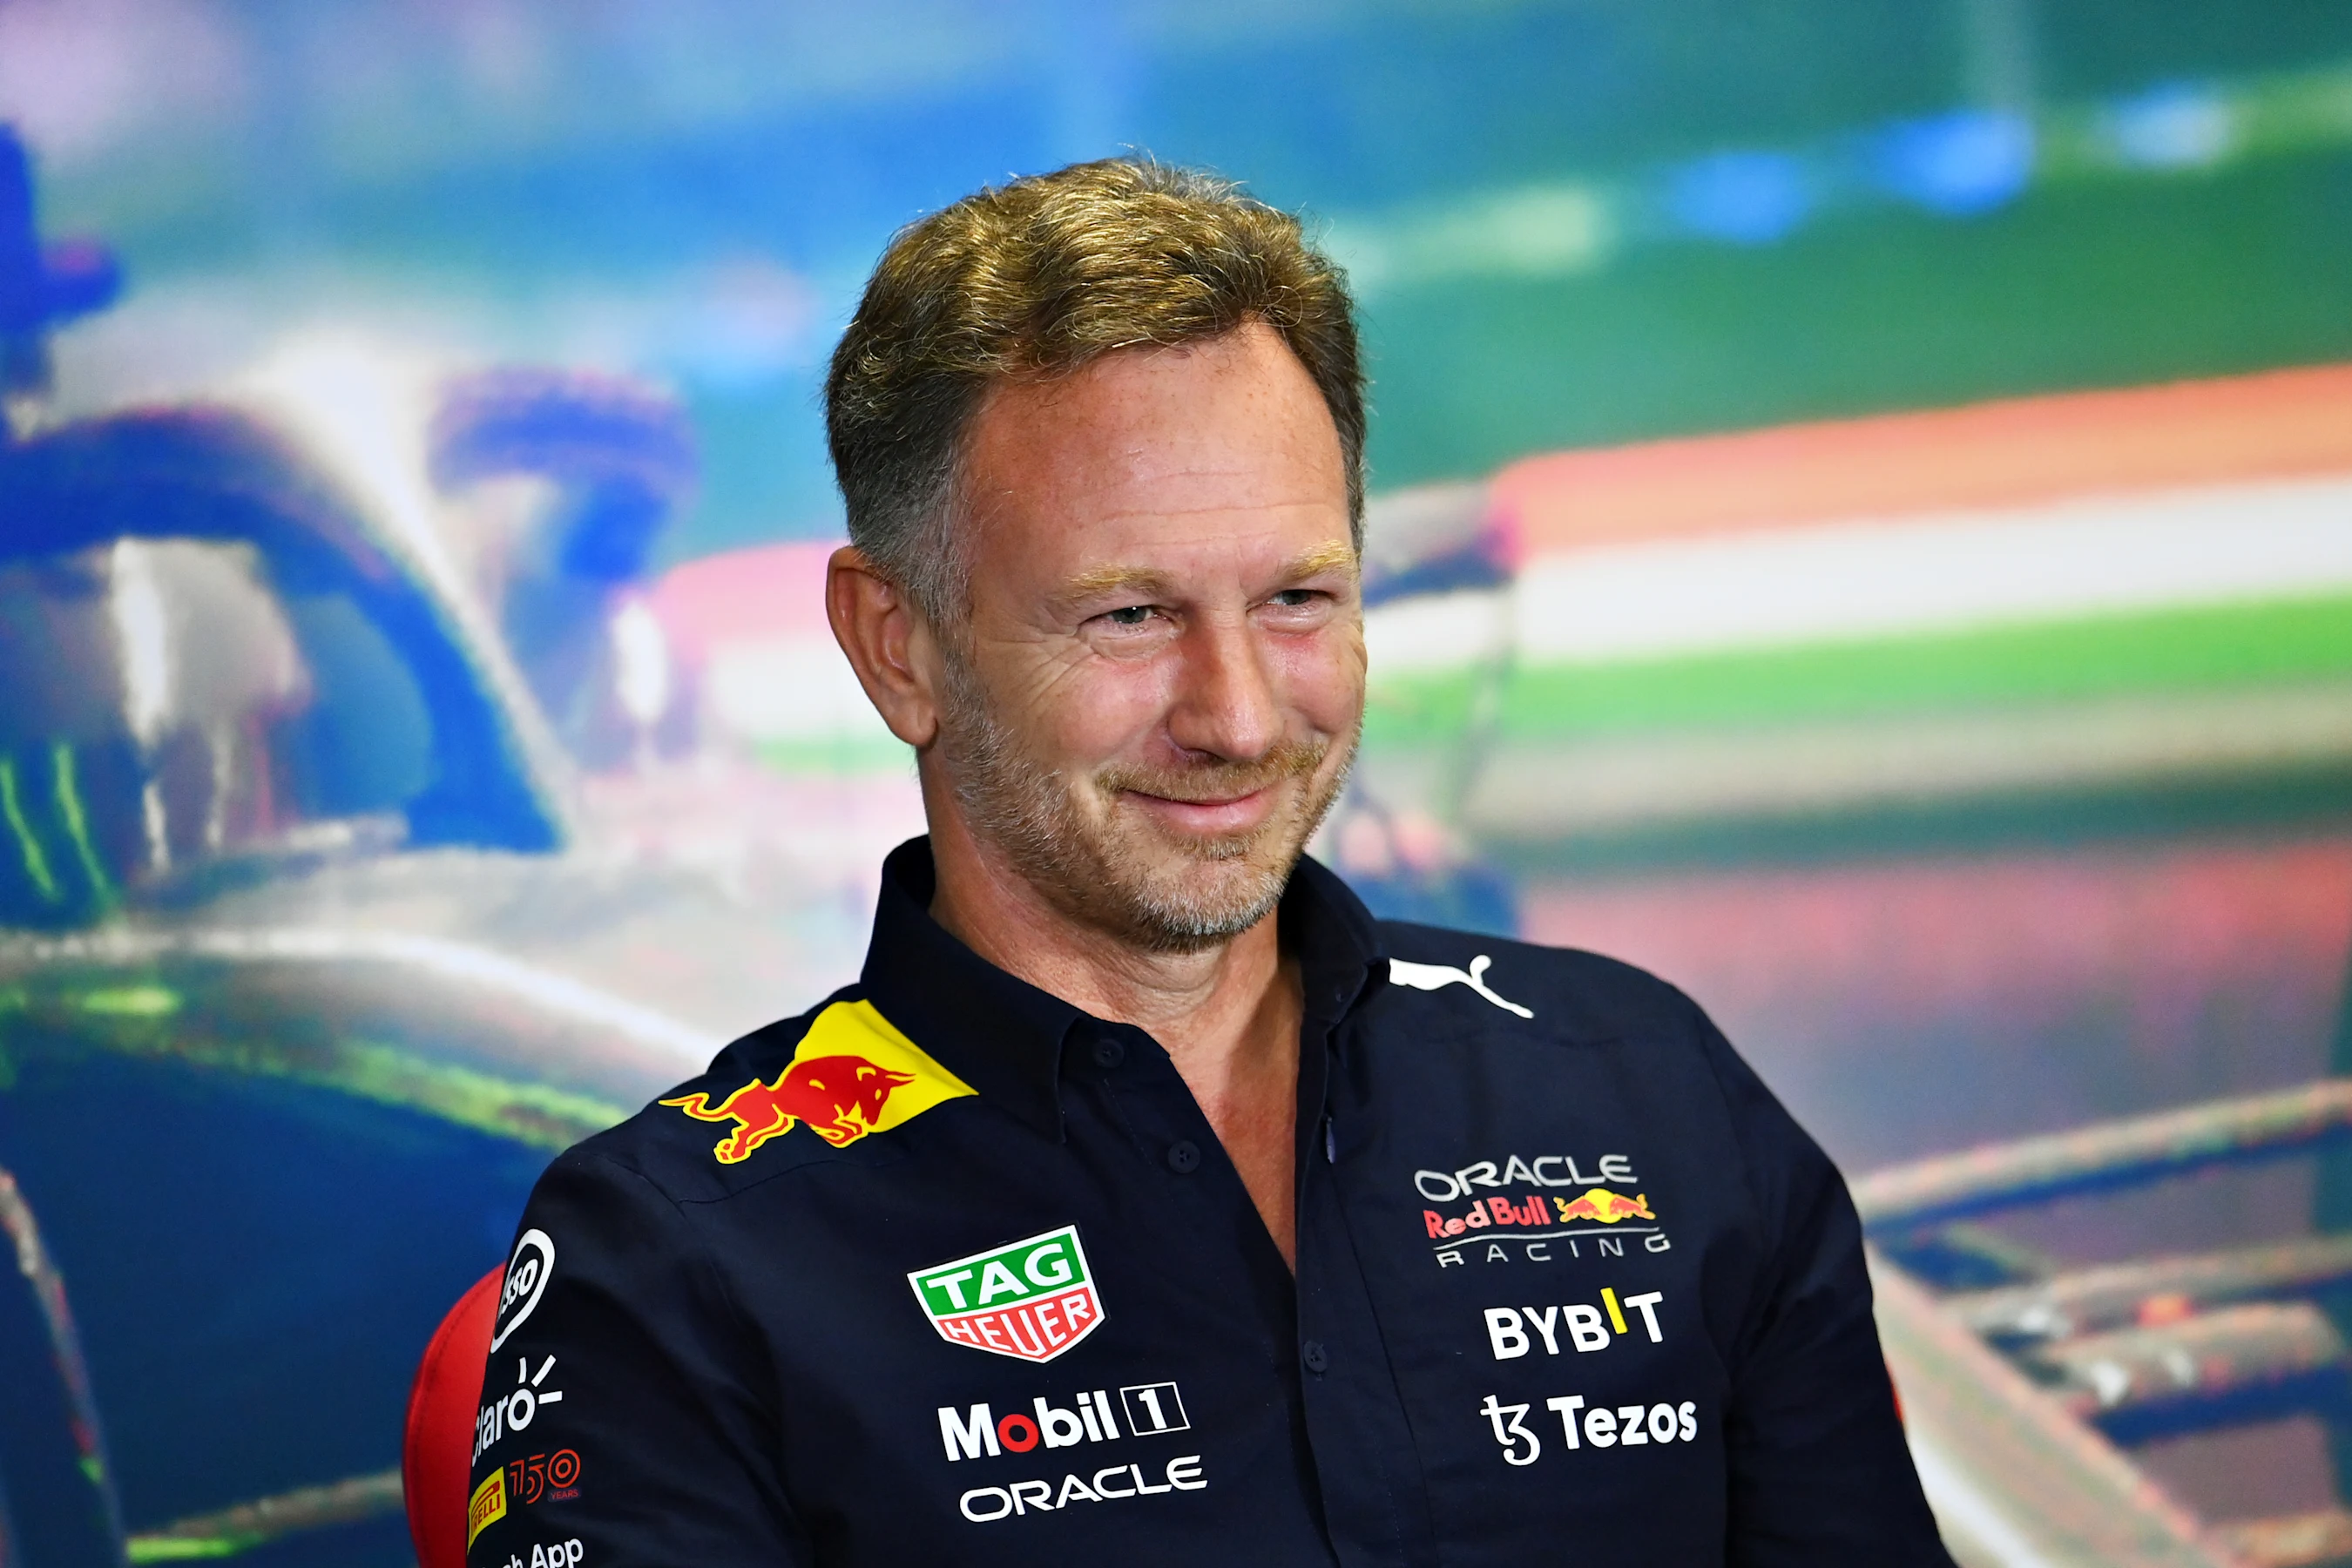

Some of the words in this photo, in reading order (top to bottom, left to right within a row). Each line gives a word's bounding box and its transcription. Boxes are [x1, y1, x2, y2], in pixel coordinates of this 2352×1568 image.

[1414, 1154, 1638, 1202] ORACLE
[1423, 1200, 1491, 1239] Red
[1486, 1195, 1551, 1226] Bull
[926, 1243, 1073, 1310] TAG
[1436, 1233, 1671, 1268] RACING
[501, 1259, 538, 1315] sso
[943, 1293, 1091, 1357] HEUER
[1484, 1287, 1664, 1361] BYBIT
[937, 1390, 1120, 1462] Mobil
[1138, 1389, 1167, 1430] 1
[1546, 1395, 1698, 1450] Tezos
[510, 1449, 581, 1504] 150
[551, 1489, 579, 1500] YEARS
[959, 1455, 1208, 1523] ORACLE
[531, 1538, 584, 1568] App
